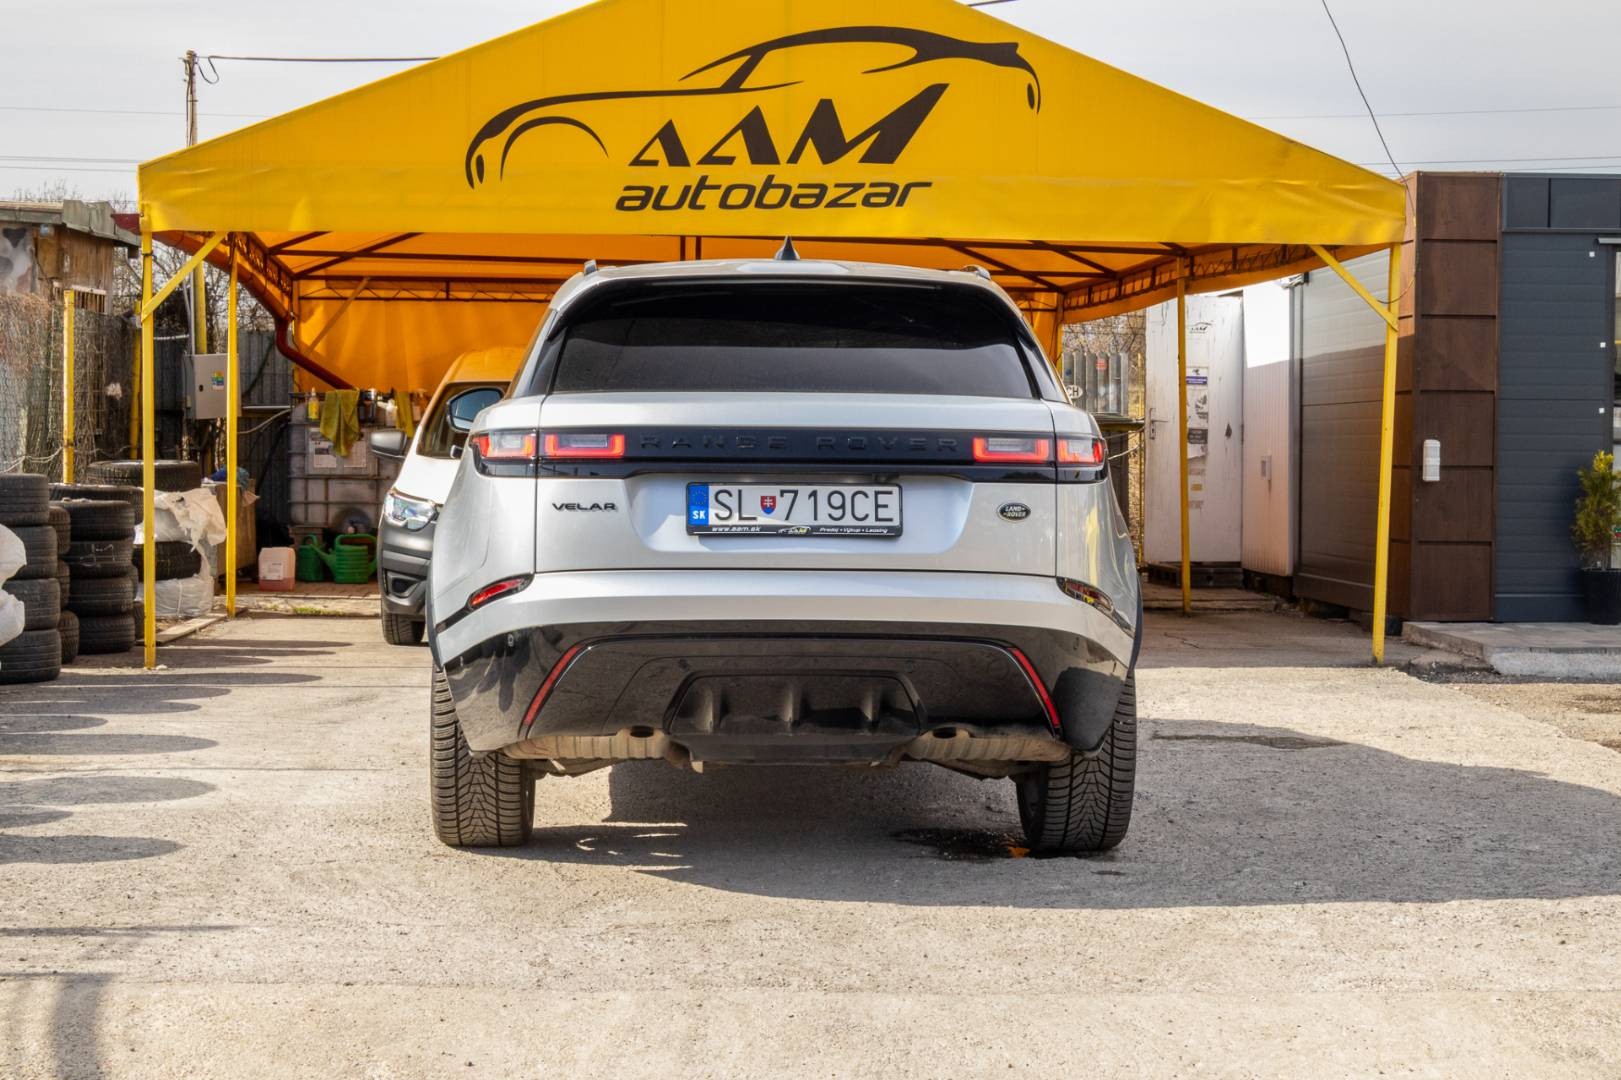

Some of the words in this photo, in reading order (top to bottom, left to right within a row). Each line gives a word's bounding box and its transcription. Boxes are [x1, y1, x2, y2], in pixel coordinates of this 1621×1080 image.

[628, 83, 950, 167] AAM
[615, 174, 933, 212] autobazar
[640, 435, 787, 449] RANGE
[816, 436, 958, 452] ROVER
[552, 502, 616, 511] VELAR
[692, 510, 706, 519] SK
[714, 489, 758, 521] SL
[780, 489, 894, 522] 719CE
